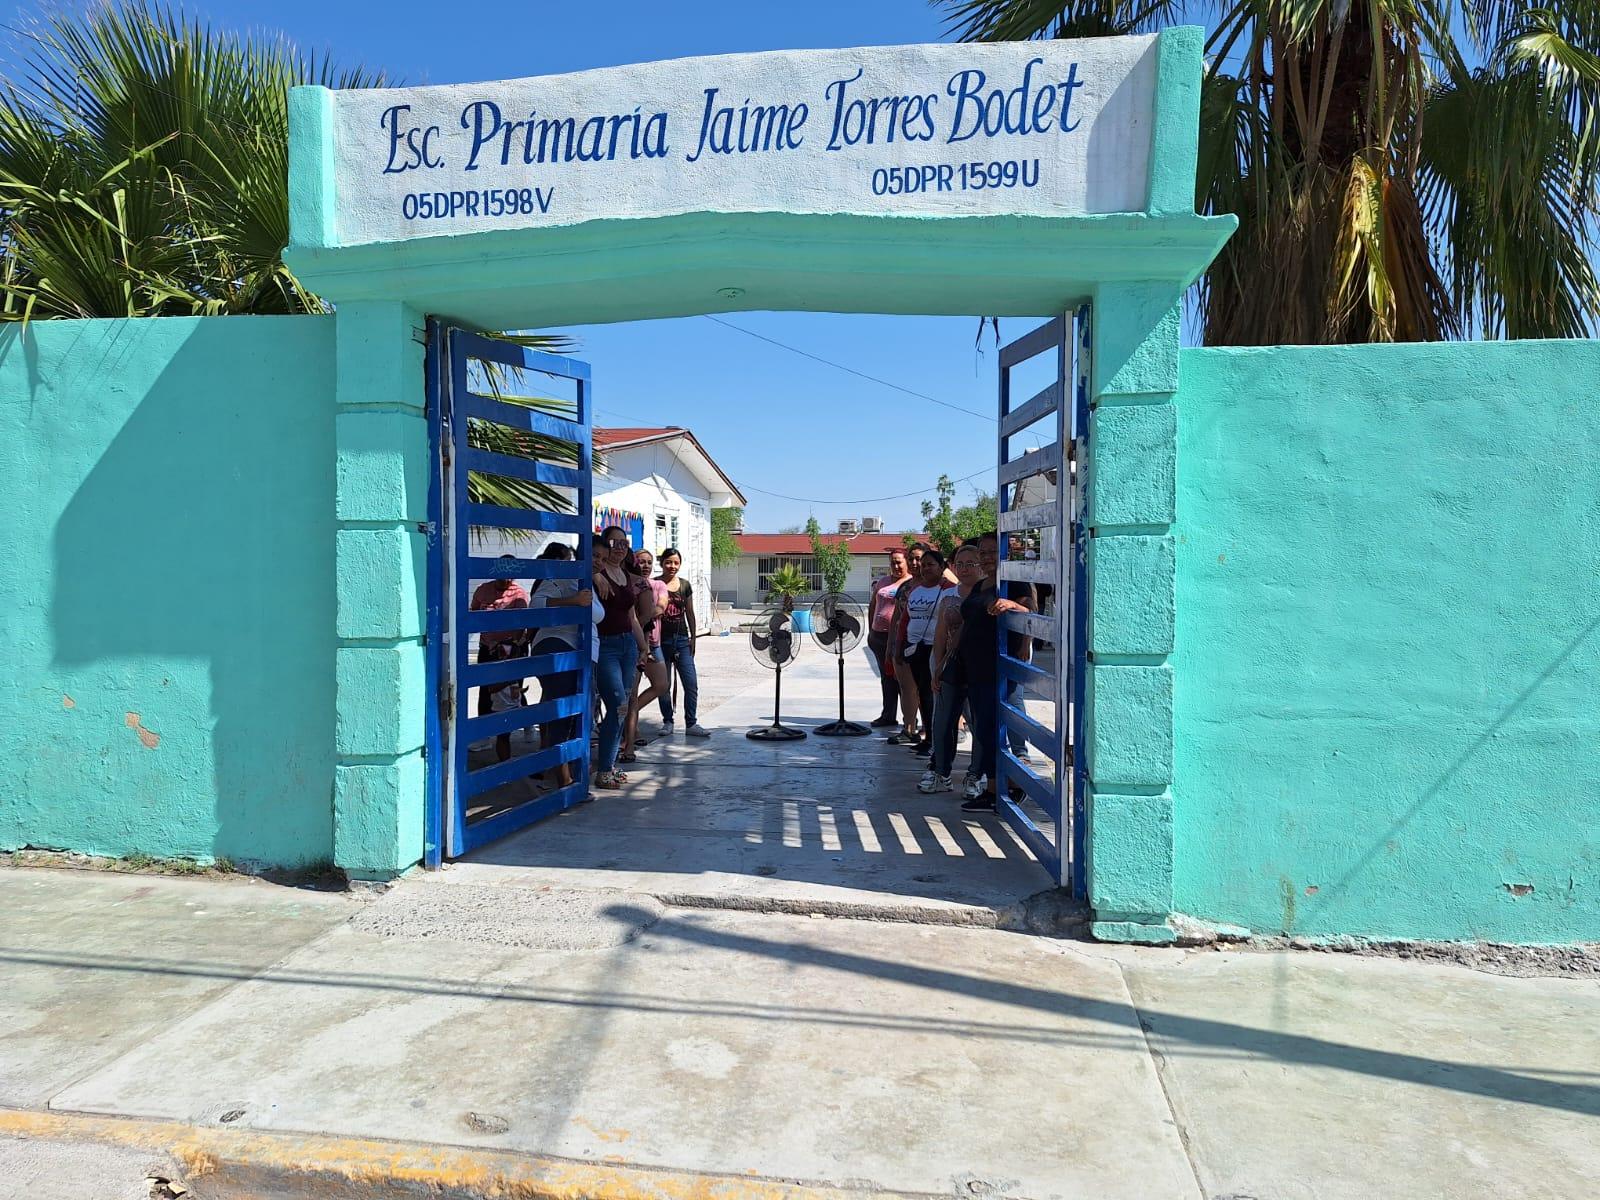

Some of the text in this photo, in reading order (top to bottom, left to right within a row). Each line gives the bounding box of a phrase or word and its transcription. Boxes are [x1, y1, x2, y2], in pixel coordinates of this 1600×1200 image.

[381, 57, 1084, 174] Esc. Primaria Jaime Torres Bodet
[872, 158, 1040, 196] 05DPR1599U
[402, 186, 554, 220] 05DPR1598V
